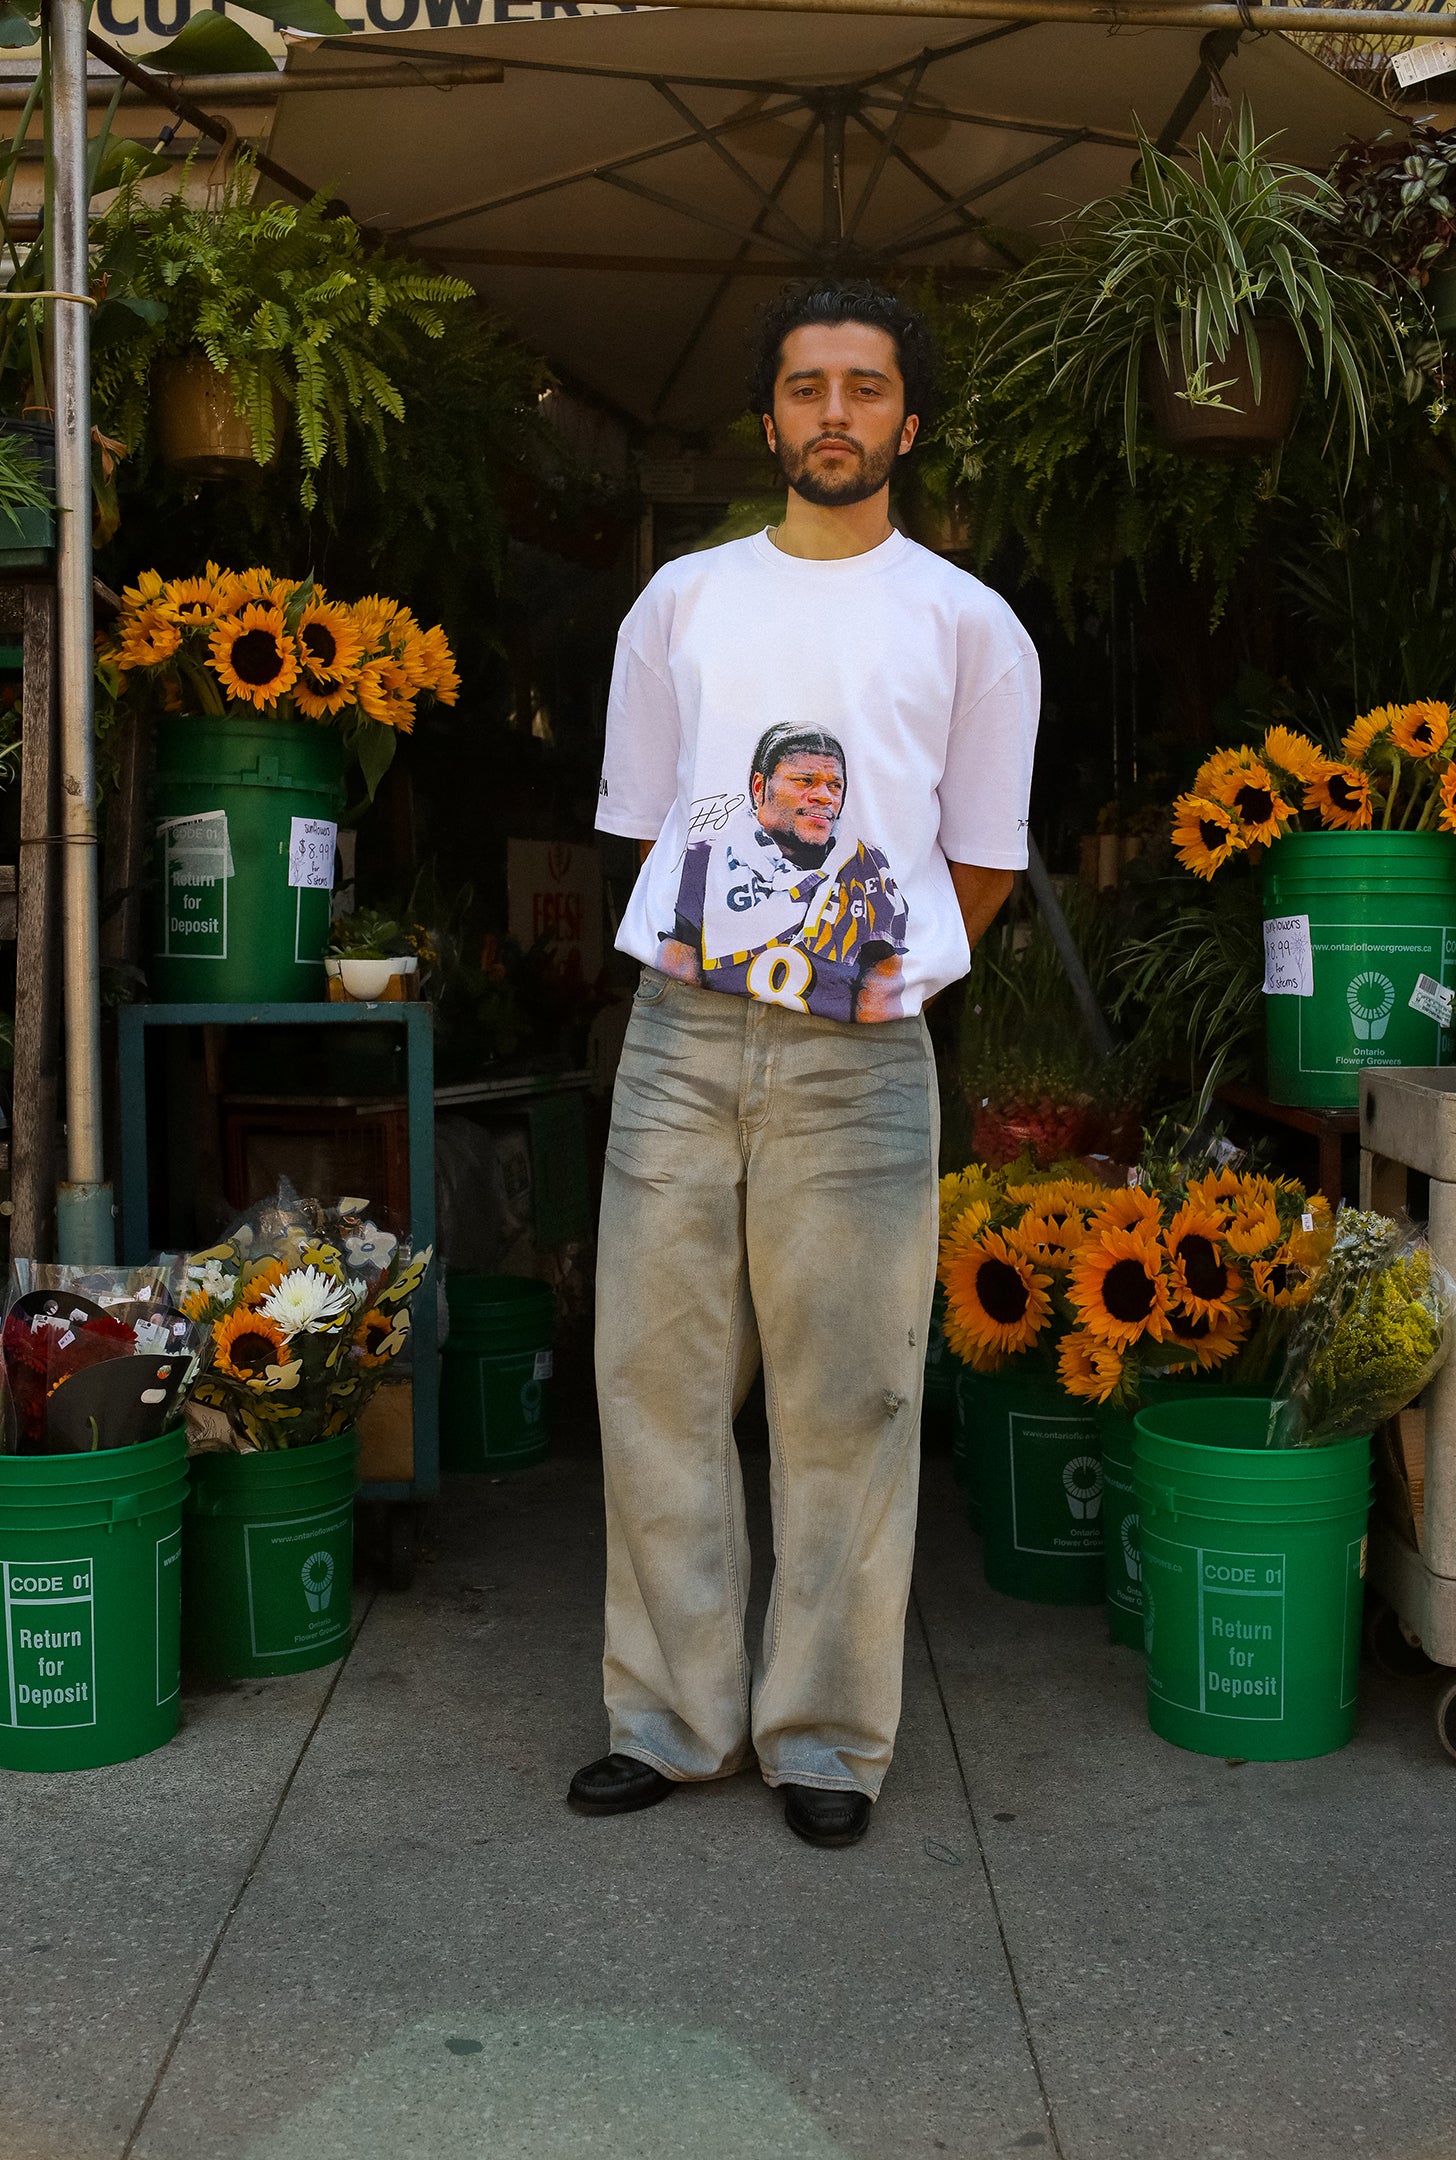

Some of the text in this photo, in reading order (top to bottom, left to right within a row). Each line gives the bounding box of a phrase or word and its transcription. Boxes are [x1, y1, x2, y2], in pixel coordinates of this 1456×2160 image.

[98, 0, 226, 37] CU
[172, 828, 203, 841] CODE
[172, 872, 215, 887] Return
[183, 894, 202, 910] for
[171, 917, 220, 936] Deposit
[1335, 1056, 1402, 1065] Flower Growers
[1353, 1047, 1386, 1056] Ontario
[10, 1573, 90, 1593] CODE 01
[1204, 1565, 1281, 1584] CODE 01
[1211, 1616, 1273, 1640] Return
[19, 1629, 82, 1649] Return
[1228, 1646, 1255, 1667] for
[37, 1657, 65, 1677] for
[1208, 1671, 1277, 1698] Deposit
[18, 1682, 88, 1709] Deposit
